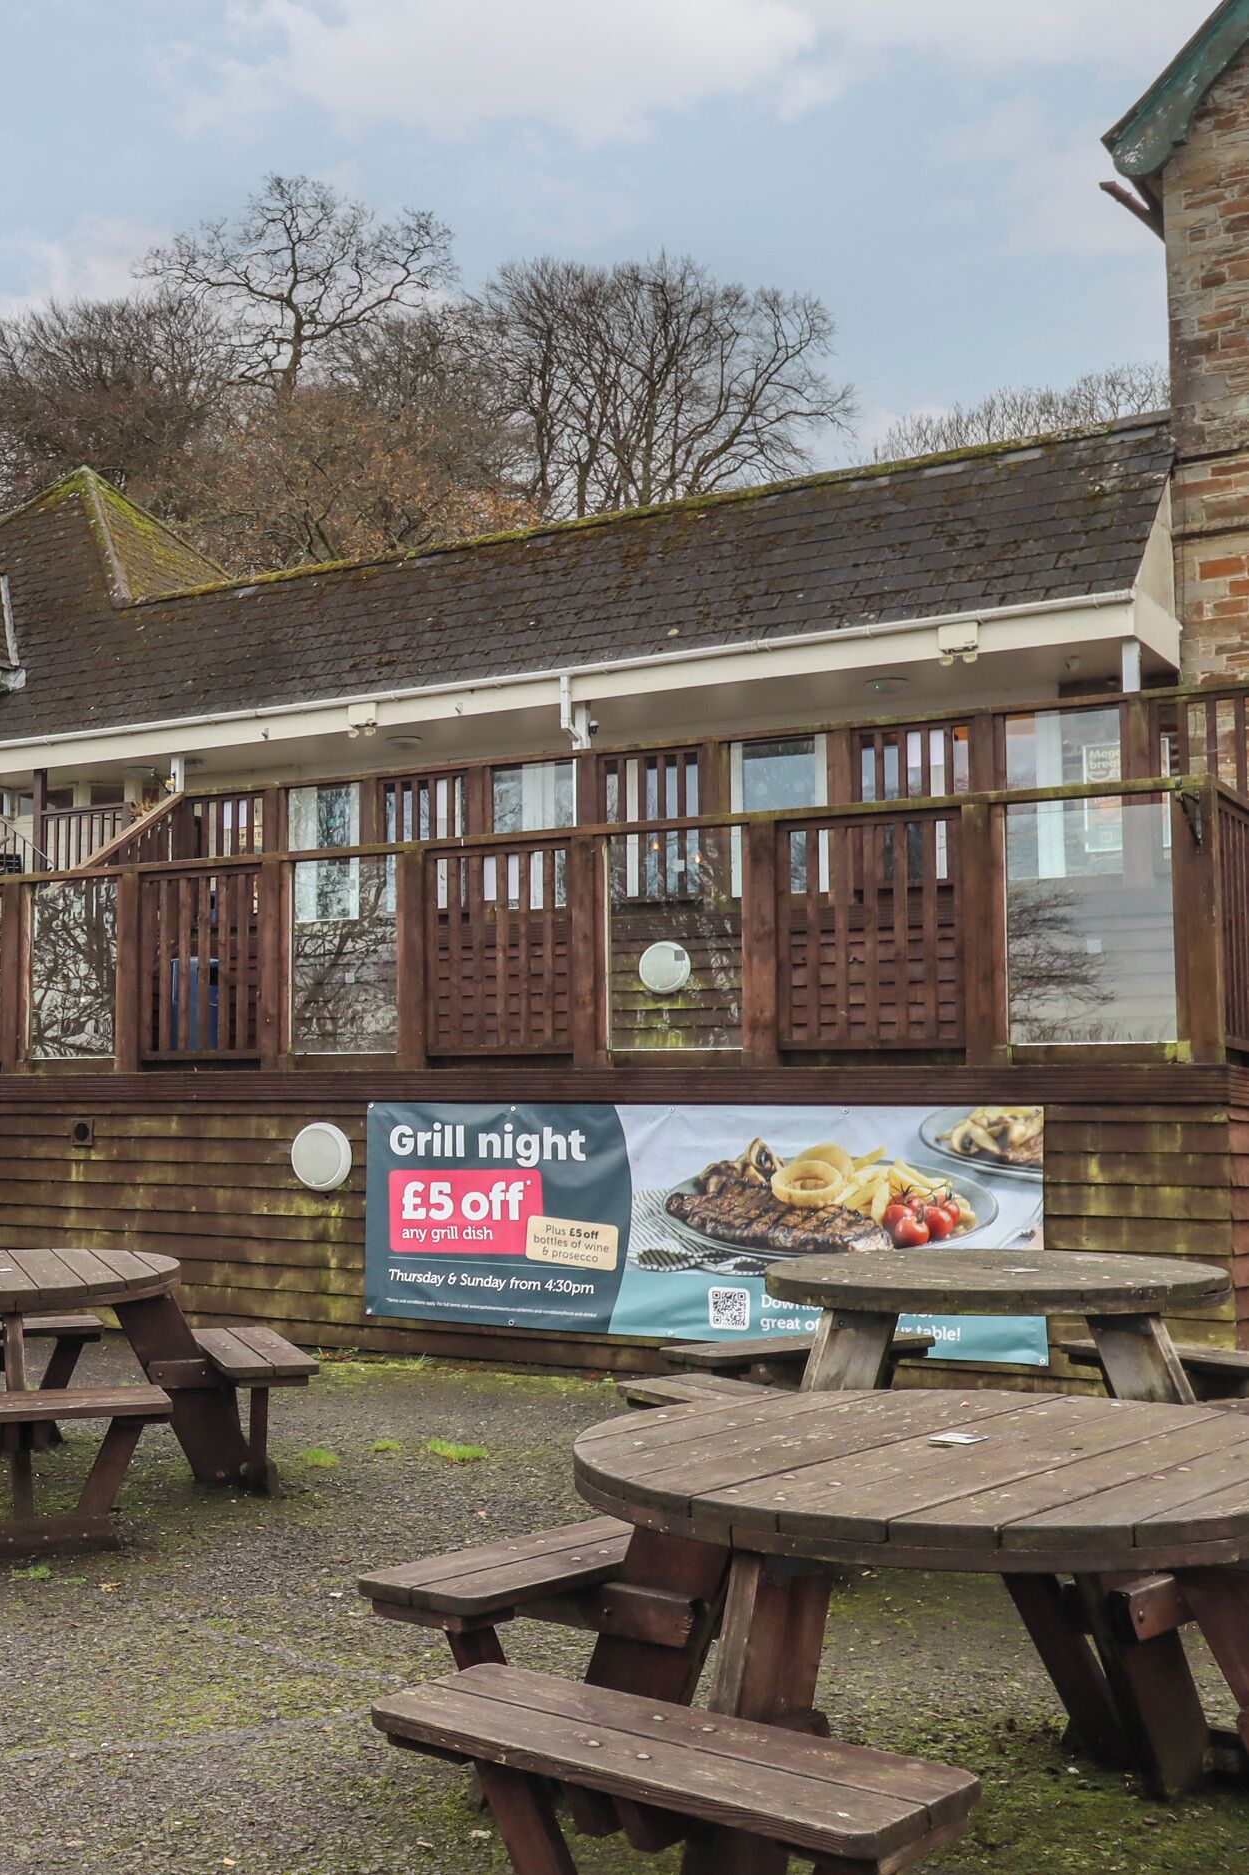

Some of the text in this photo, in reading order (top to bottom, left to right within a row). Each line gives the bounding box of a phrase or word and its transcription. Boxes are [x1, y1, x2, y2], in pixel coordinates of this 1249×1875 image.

[389, 1122, 586, 1168] Grill night
[401, 1181, 454, 1221] £5
[401, 1225, 494, 1243] any grill dish
[545, 1224, 599, 1240] Plus £5 off
[533, 1234, 609, 1253] bottles of wine
[541, 1246, 599, 1263] & prosecco
[388, 1268, 595, 1296] Thursday & Sunday from 4:30pm
[760, 1317, 801, 1331] great
[916, 1325, 961, 1341] table!
